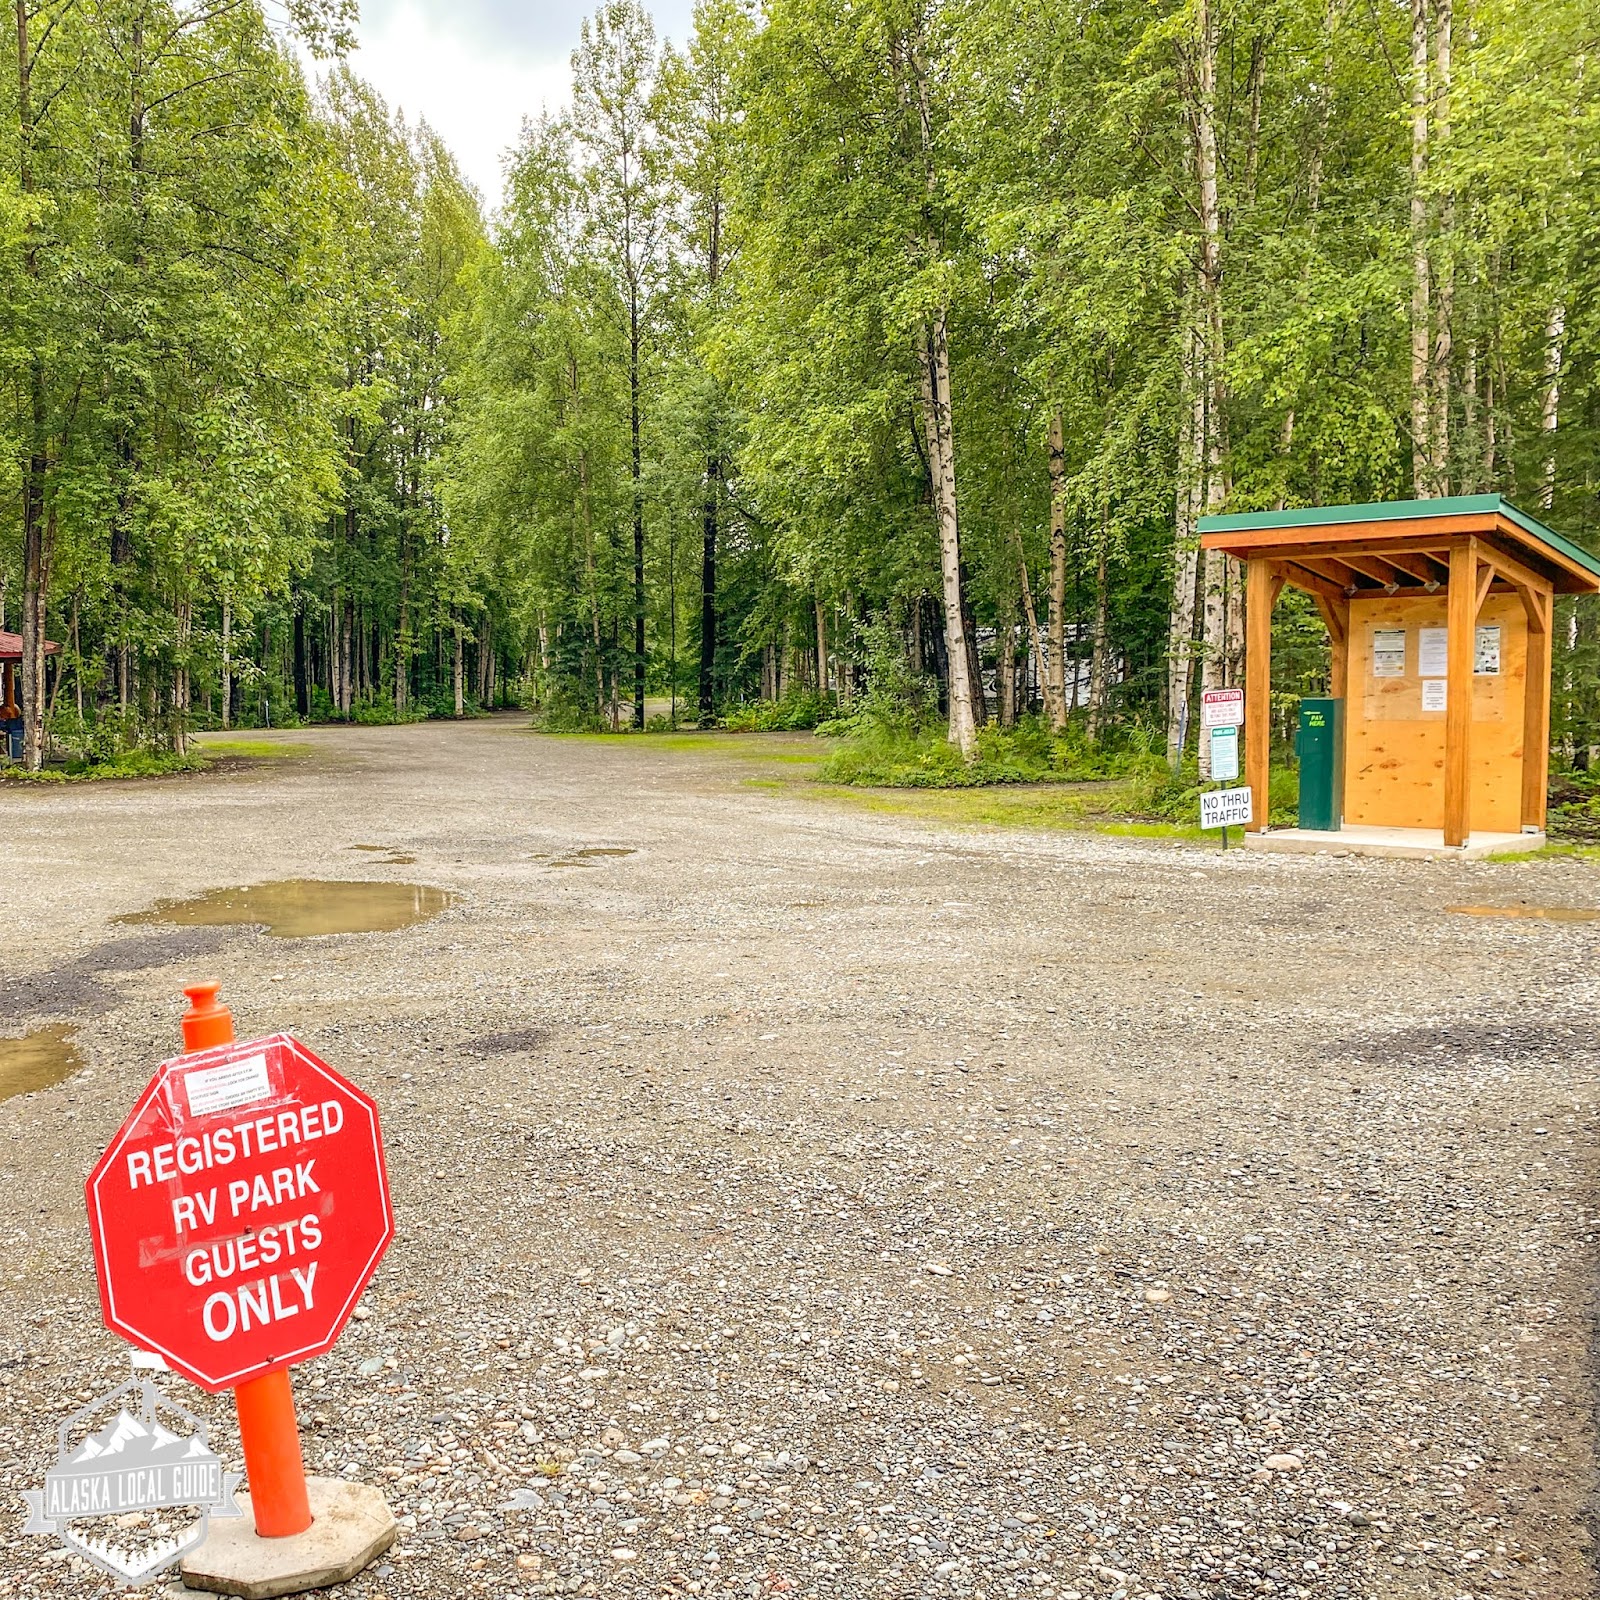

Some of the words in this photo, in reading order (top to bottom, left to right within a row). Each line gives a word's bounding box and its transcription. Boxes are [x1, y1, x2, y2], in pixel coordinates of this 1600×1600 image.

[1206, 691, 1240, 702] ATTENTION
[1204, 797, 1218, 810] NO
[1221, 792, 1249, 807] THRU
[1205, 807, 1248, 824] TRAFFIC
[127, 1100, 344, 1190] REGISTERED
[172, 1188, 218, 1234] RV
[228, 1159, 320, 1218] PARK
[185, 1214, 322, 1286] GUESTS
[202, 1262, 318, 1342] ONLY
